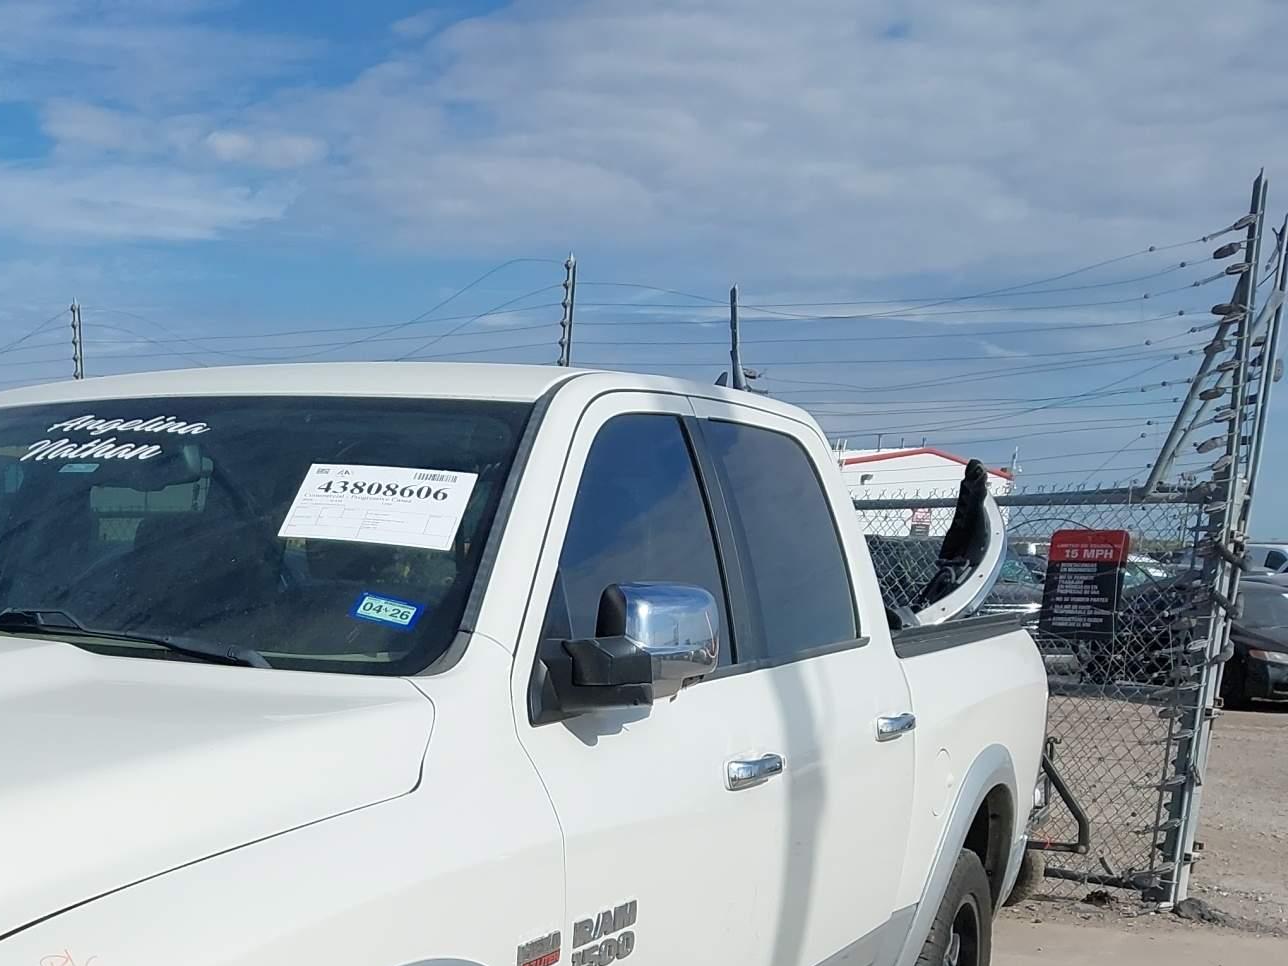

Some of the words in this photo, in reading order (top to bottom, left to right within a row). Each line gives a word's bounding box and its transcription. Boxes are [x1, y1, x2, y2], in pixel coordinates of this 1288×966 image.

[47, 415, 211, 436] Angelina
[20, 438, 162, 462] Nathan
[317, 480, 451, 502] 43808606
[1065, 549, 1079, 559] 15
[1083, 549, 1114, 559] MPH
[362, 601, 383, 613] 04
[389, 608, 411, 620] 26
[572, 899, 638, 949] RAM
